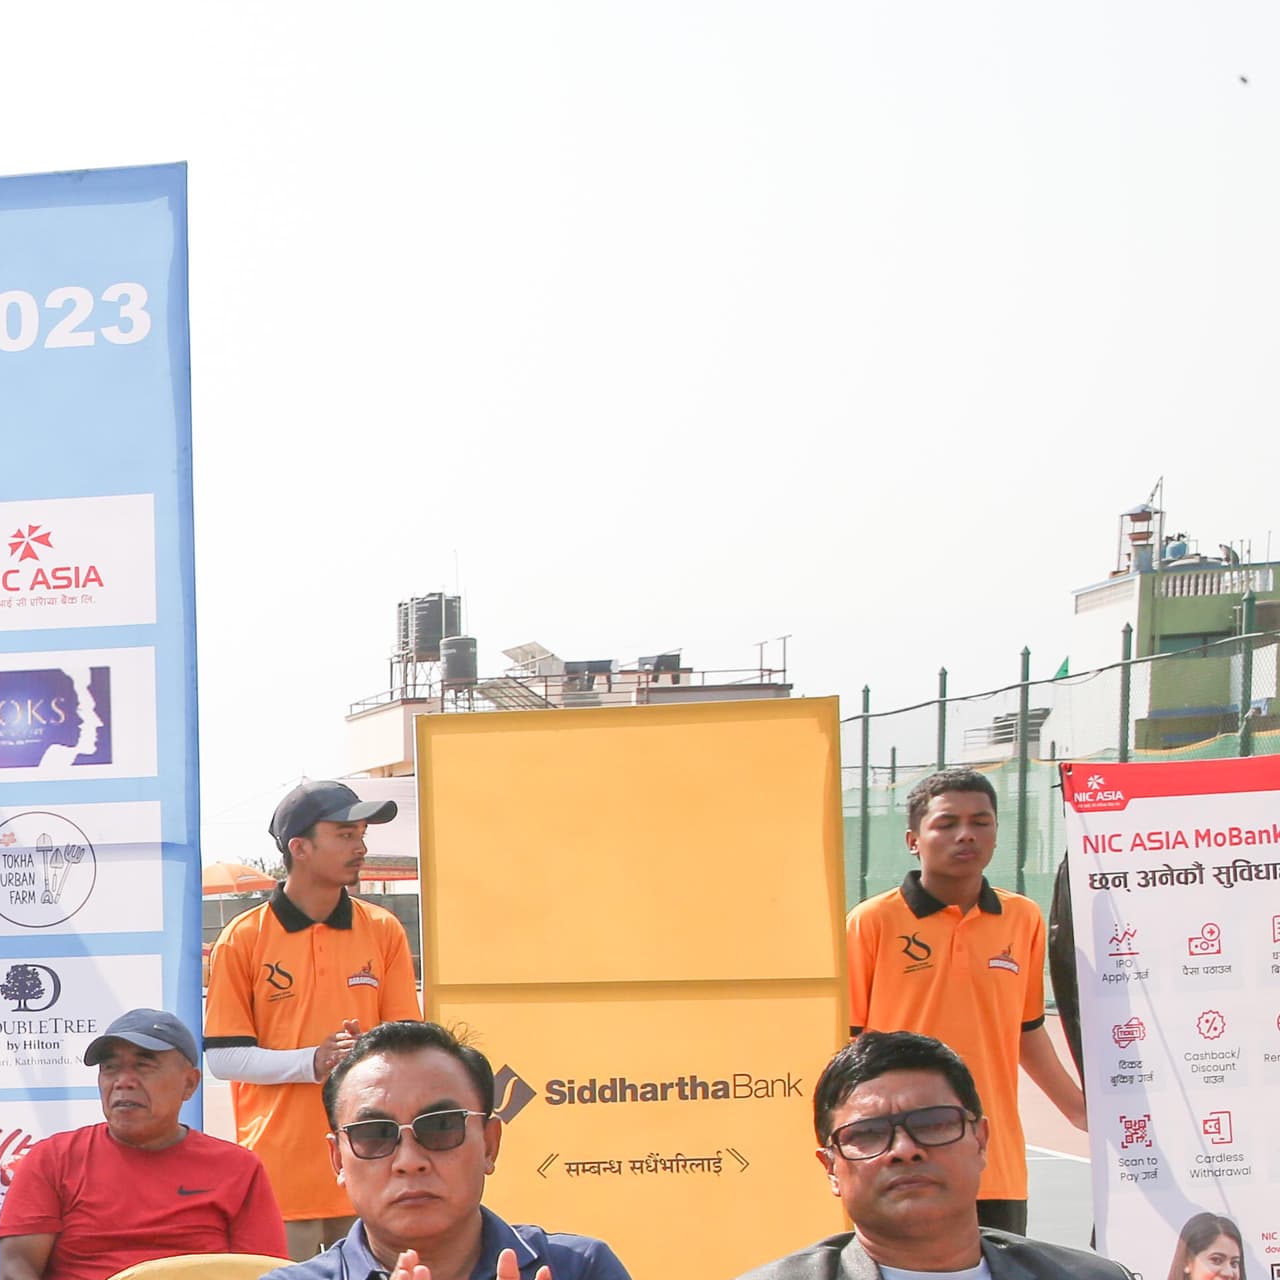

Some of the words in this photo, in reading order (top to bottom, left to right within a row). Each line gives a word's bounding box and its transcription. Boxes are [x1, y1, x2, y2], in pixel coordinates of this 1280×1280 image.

[29, 565, 104, 591] ASIA
[1073, 792, 1093, 802] NIC
[1096, 790, 1124, 801] ASIA
[1082, 834, 1123, 854] NIC
[1130, 830, 1189, 851] ASIA
[2, 853, 34, 869] TOKHA
[0, 871, 36, 888] URBAN
[1089, 871, 1131, 893] छन्
[1212, 858, 1280, 889] सुविधा
[9, 888, 37, 905] FARM
[1115, 959, 1133, 969] IPO
[1102, 972, 1130, 984] Apply
[6, 1040, 19, 1052] by
[22, 1037, 61, 1050] Hilton
[1184, 1047, 1241, 1061] Cashback/
[1191, 1061, 1236, 1074] Discount
[1118, 1157, 1144, 1168] Scan
[1147, 1156, 1158, 1166] to
[1195, 1152, 1245, 1164] Cardless
[564, 1158, 622, 1178] सम्बन्ध
[1190, 1166, 1251, 1178] Withdrawal
[1120, 1172, 1139, 1183] Pay
[1261, 1231, 1278, 1241] NIC
